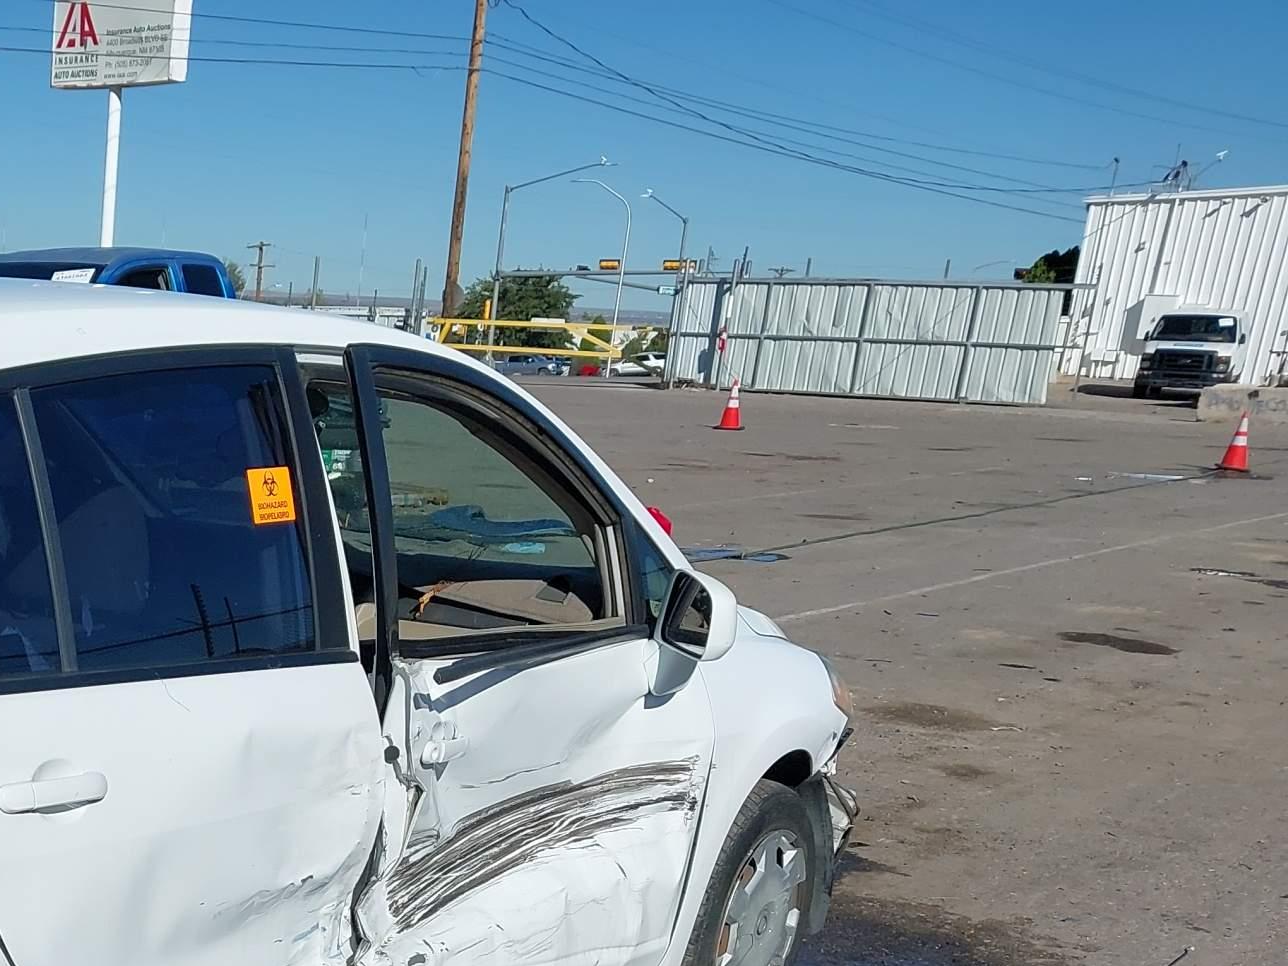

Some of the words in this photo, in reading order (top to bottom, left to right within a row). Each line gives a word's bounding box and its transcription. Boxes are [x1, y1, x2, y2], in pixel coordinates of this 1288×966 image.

[133, 25, 146, 33] Auto
[146, 23, 171, 32] Auctions
[54, 53, 99, 66] INSURANCE
[54, 70, 70, 80] AUTO
[70, 68, 99, 79] AUCTIONS
